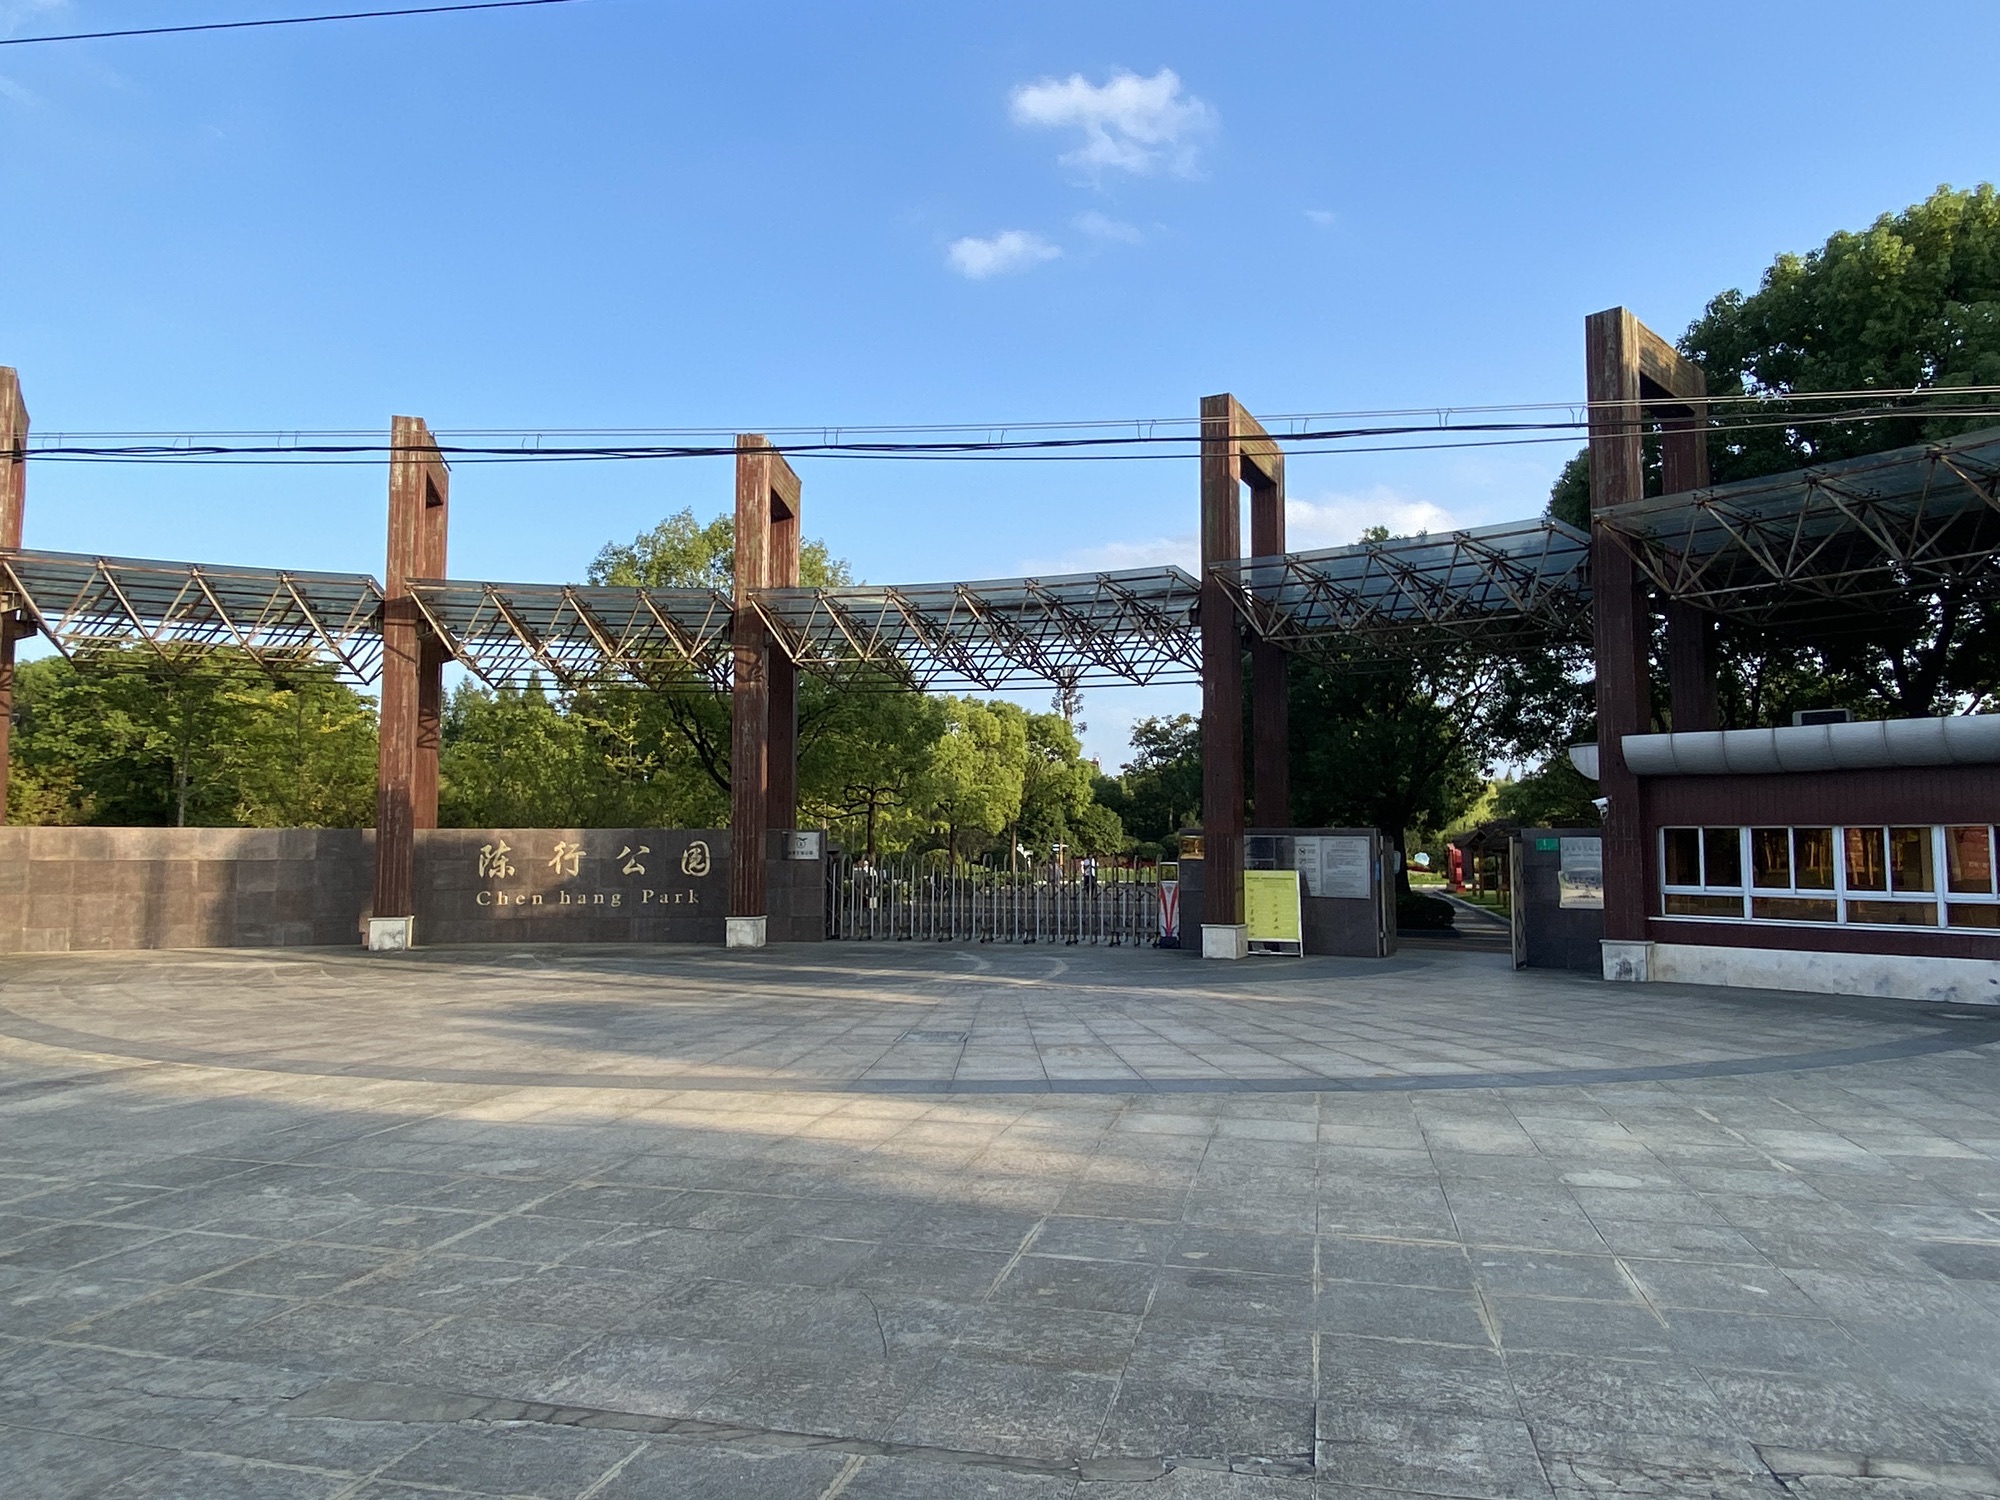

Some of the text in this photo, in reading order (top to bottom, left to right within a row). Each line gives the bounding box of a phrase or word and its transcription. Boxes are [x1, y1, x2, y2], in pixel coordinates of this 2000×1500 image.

[478, 840, 711, 878] 陈行公园
[475, 889, 699, 907] Chen hang Park
